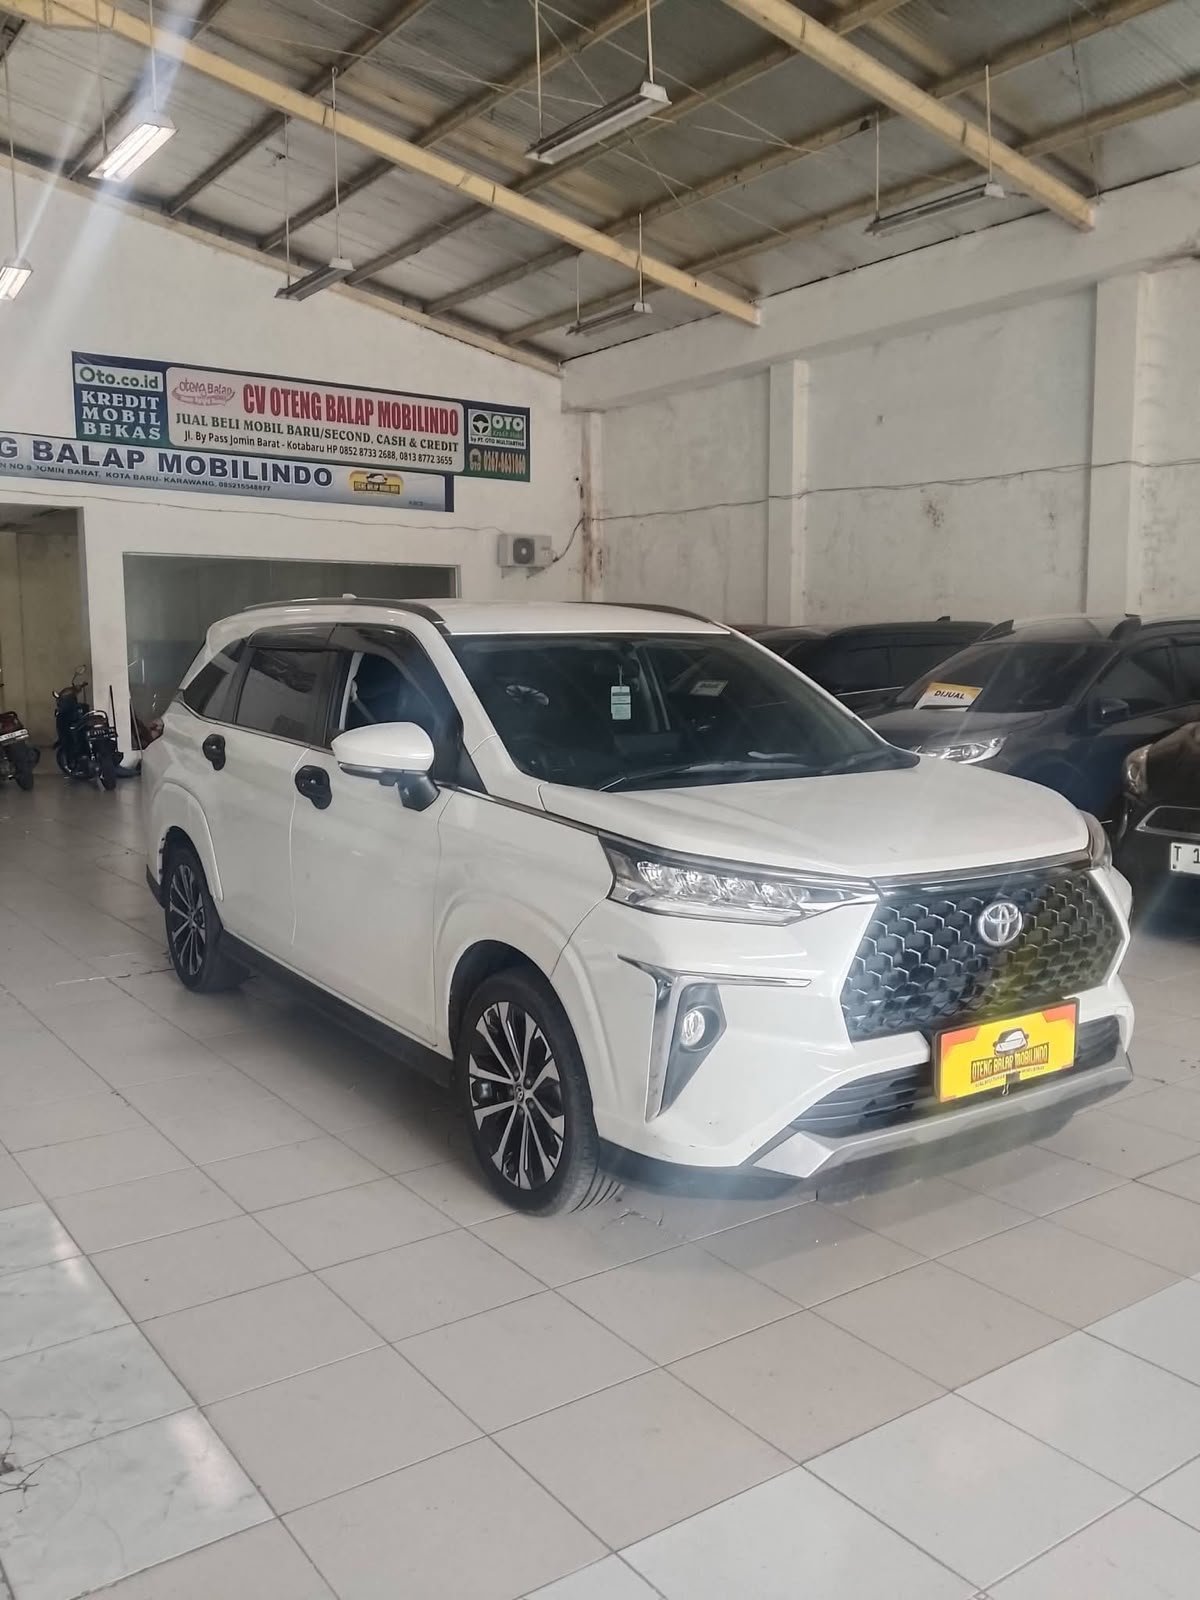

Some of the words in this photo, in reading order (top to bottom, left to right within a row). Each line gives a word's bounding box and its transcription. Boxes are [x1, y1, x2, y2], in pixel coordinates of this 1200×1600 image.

[79, 366, 159, 389] Oto.co.id
[81, 391, 159, 410] KREDIT
[243, 384, 265, 414] CV
[270, 387, 322, 420] OTENG
[325, 393, 374, 426] BALAP
[378, 400, 458, 436] MOBILINDO
[82, 407, 160, 425] MOBIL
[492, 415, 523, 431] OTO
[83, 421, 161, 440] BEKAS
[176, 413, 208, 427] JUAL
[211, 416, 240, 430] BELI
[243, 419, 284, 435] MOBIL
[376, 433, 407, 447] CASH
[409, 438, 417, 448] &
[420, 439, 458, 452] CREDIT
[195, 431, 207, 444] By
[209, 432, 228, 444] Pass
[229, 434, 255, 447] Jomin
[257, 436, 280, 448] Barat
[286, 438, 325, 453] Kotabaru
[326, 444, 338, 455] HP
[339, 446, 358, 456] 0852
[359, 447, 377, 458] 8733
[400, 451, 417, 462] 0813
[418, 453, 435, 463] 8772
[436, 454, 453, 465] 3655
[33, 440, 145, 469] BALAP
[158, 452, 332, 486] MOBILINDO
[105, 472, 131, 480] KOTA
[934, 690, 964, 699] DIJUAL
[1174, 845, 1182, 861] T
[972, 1060, 993, 1082] OTENG
[1014, 1044, 1048, 1067] MOBILINDO
